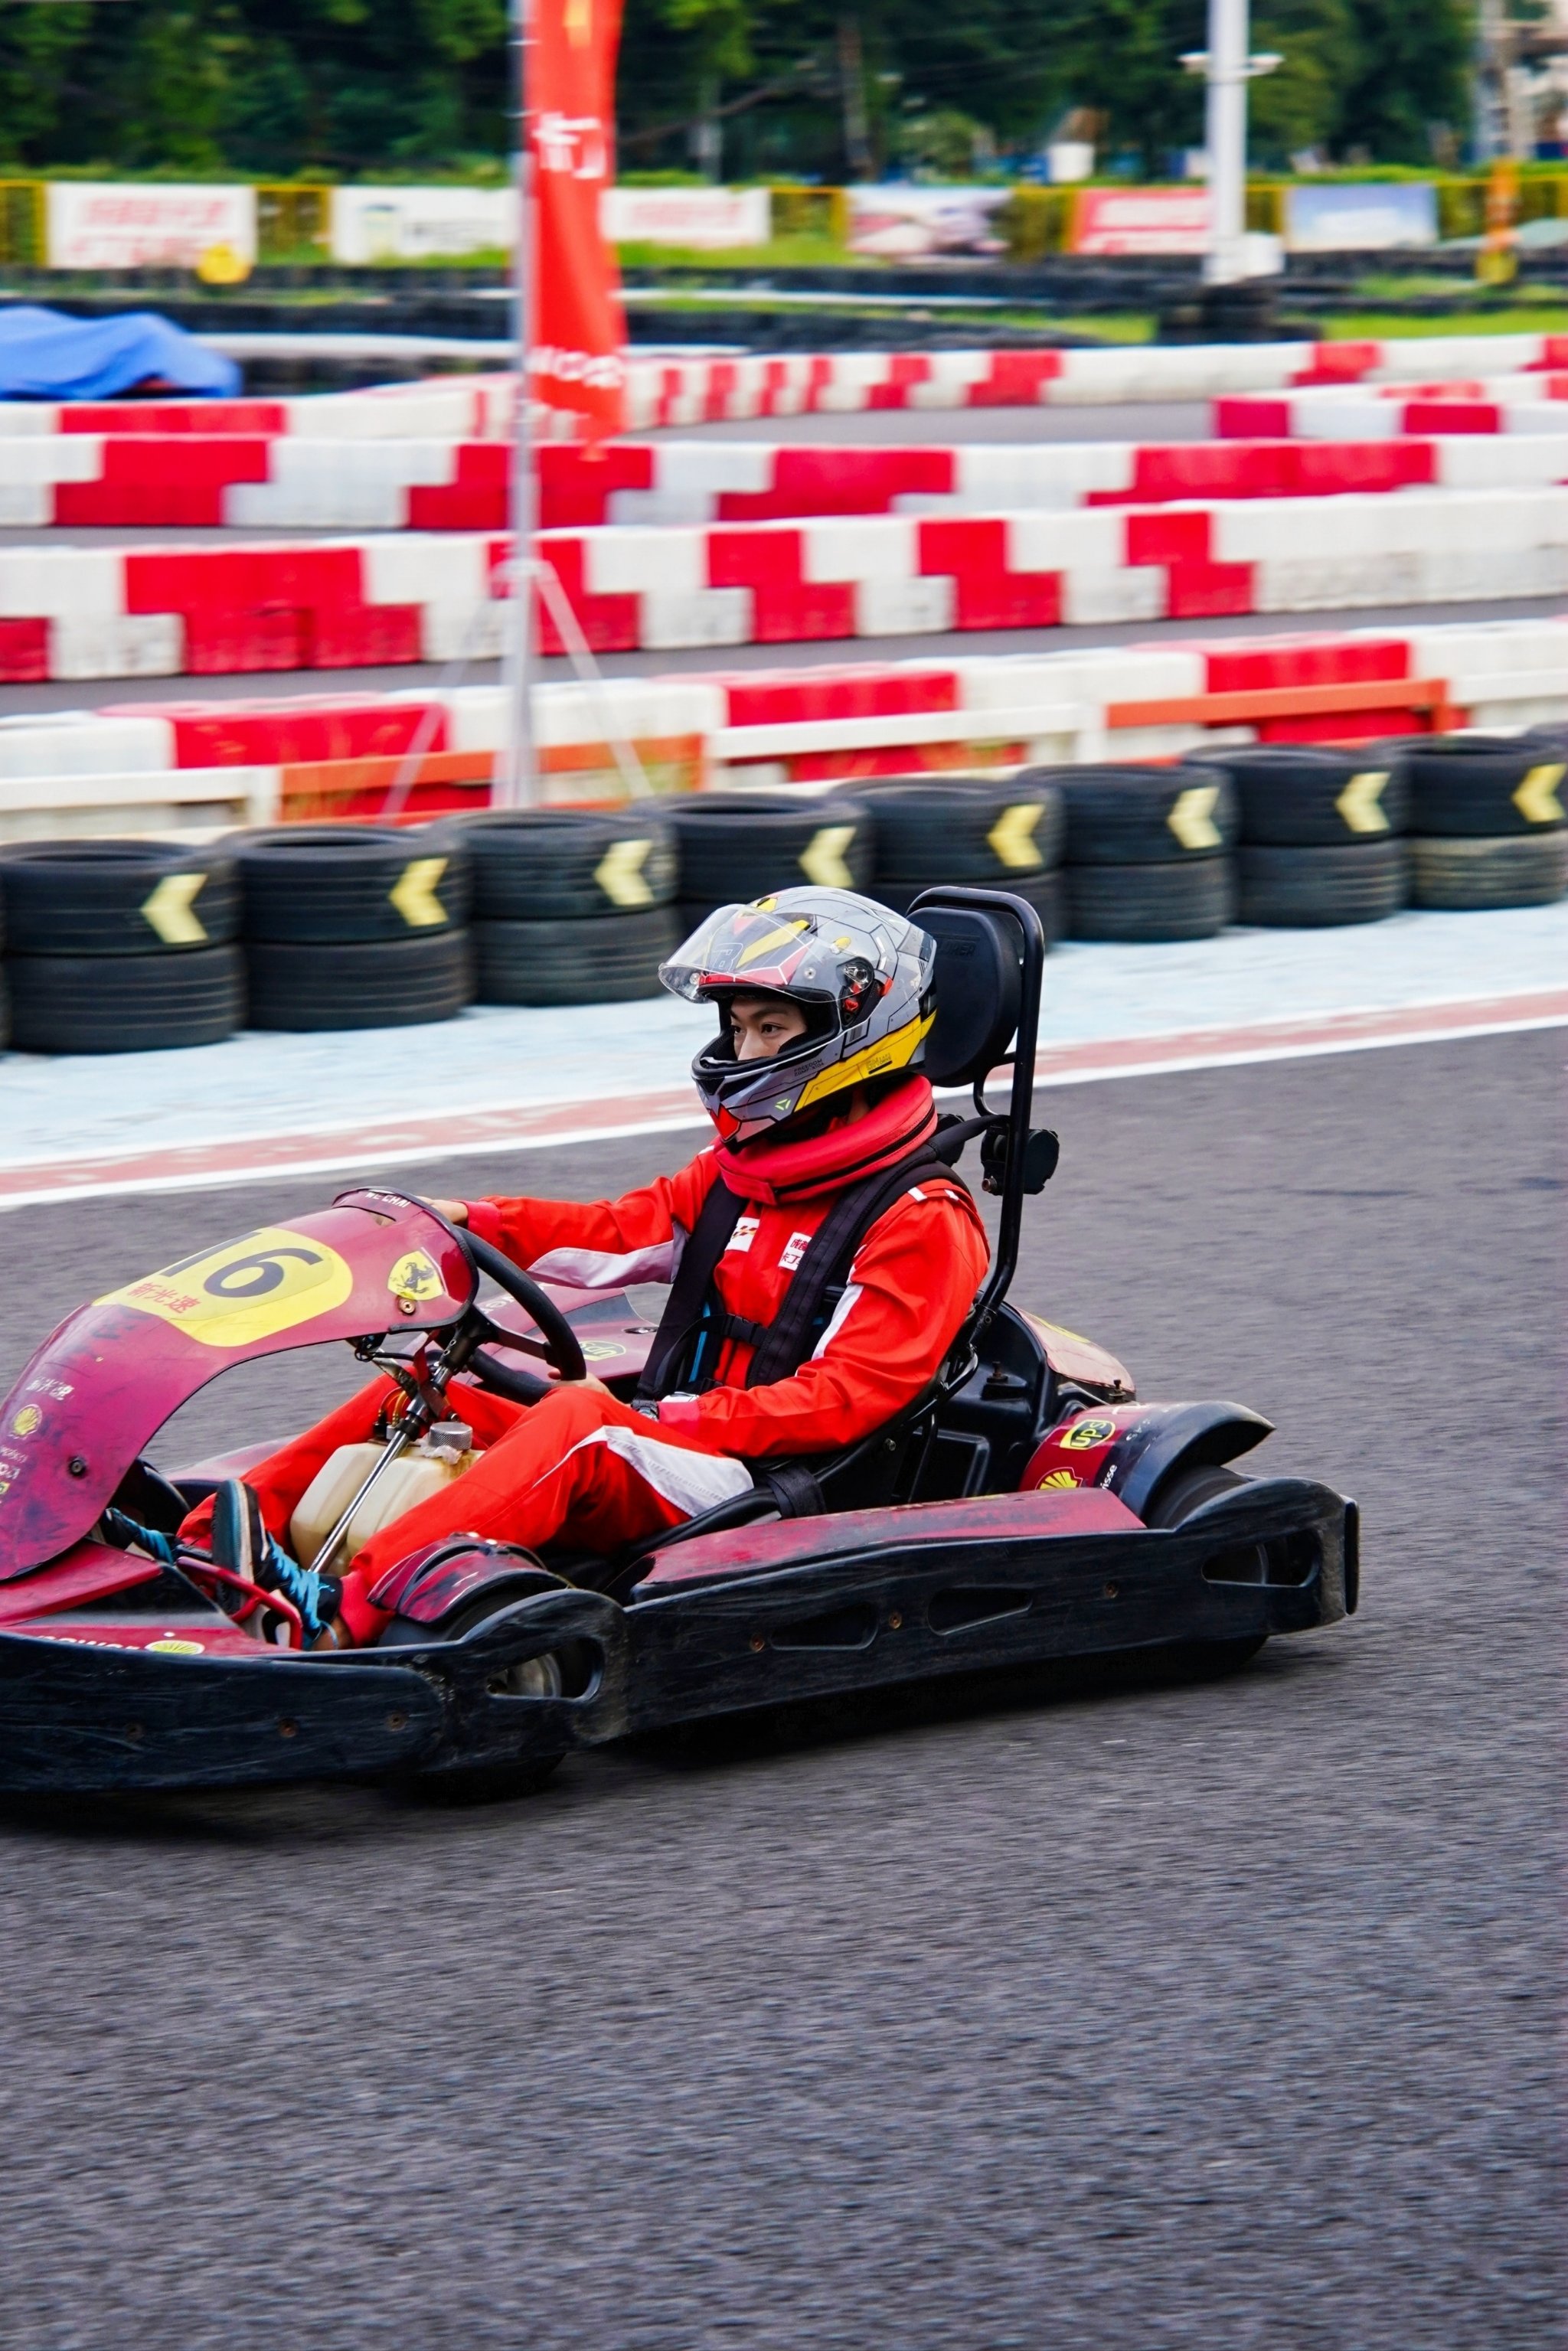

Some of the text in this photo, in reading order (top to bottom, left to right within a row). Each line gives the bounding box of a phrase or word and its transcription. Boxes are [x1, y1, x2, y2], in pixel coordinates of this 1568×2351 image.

[158, 1231, 324, 1298] 16
[781, 1252, 801, 1265] 卡丁
[126, 1282, 201, 1314] 新光速
